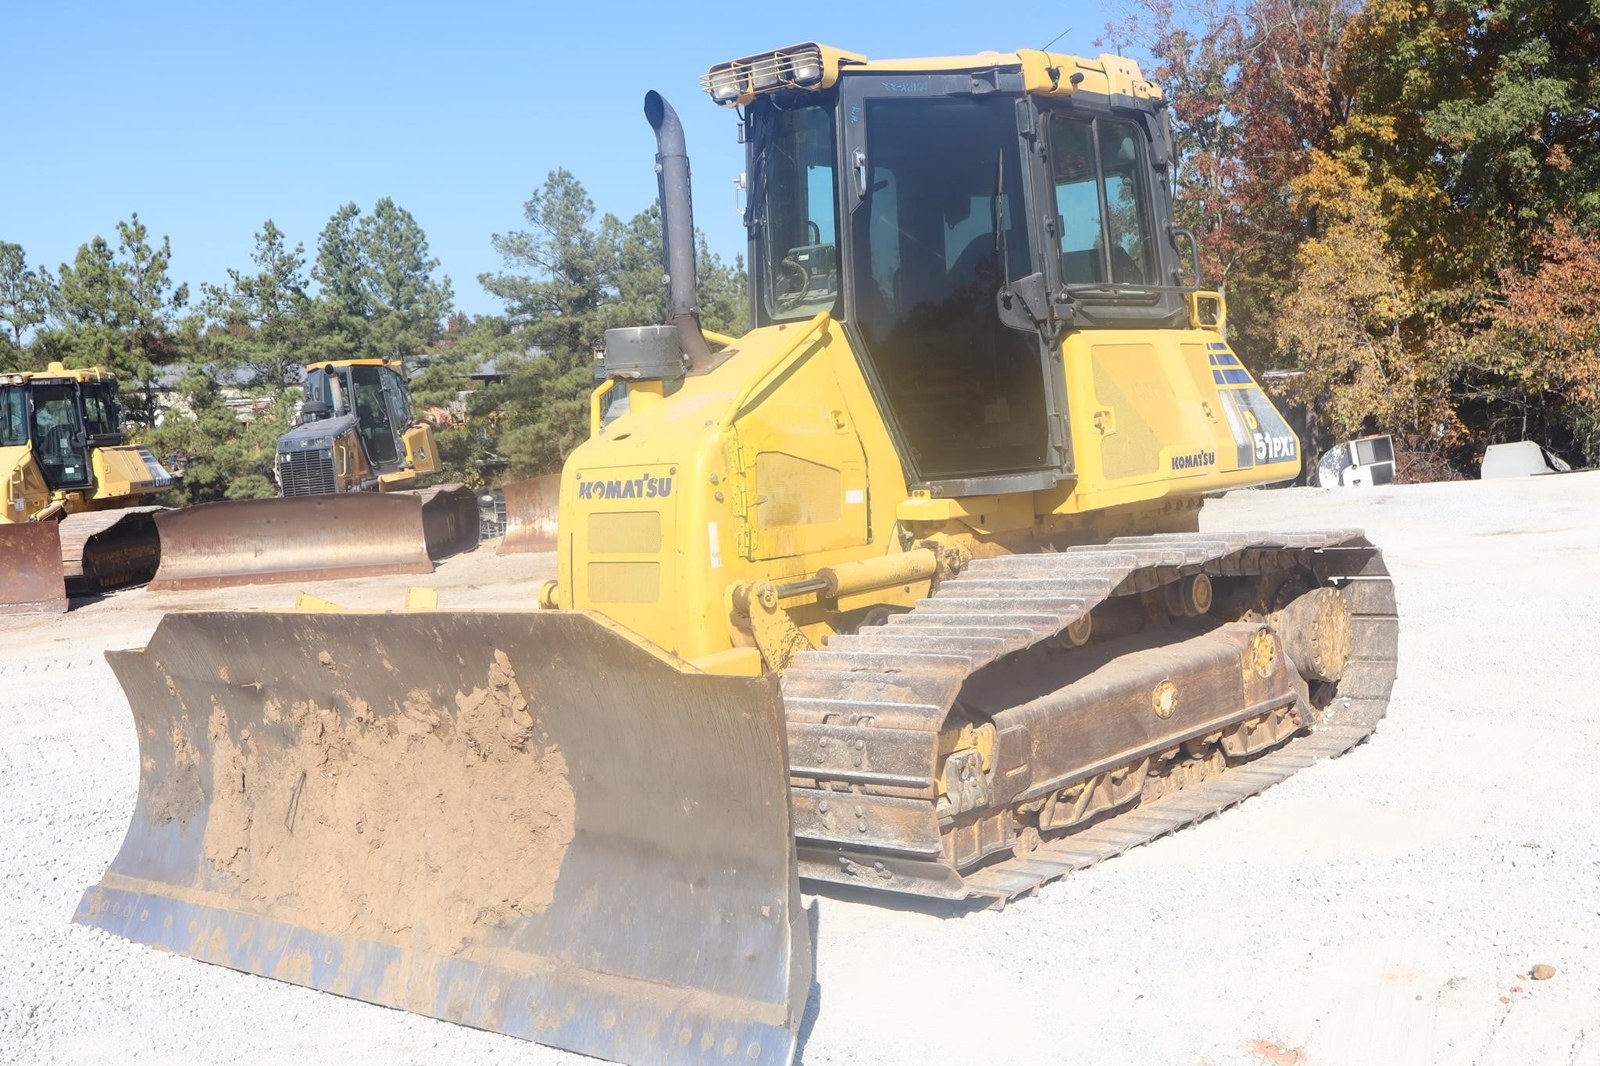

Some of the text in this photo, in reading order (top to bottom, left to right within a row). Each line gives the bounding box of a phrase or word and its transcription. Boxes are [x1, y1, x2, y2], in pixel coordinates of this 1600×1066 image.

[1243, 411, 1258, 430] D
[1253, 433, 1294, 460] 51PXi
[1172, 450, 1215, 470] KOMATSU
[579, 473, 672, 499] KOMATSU
